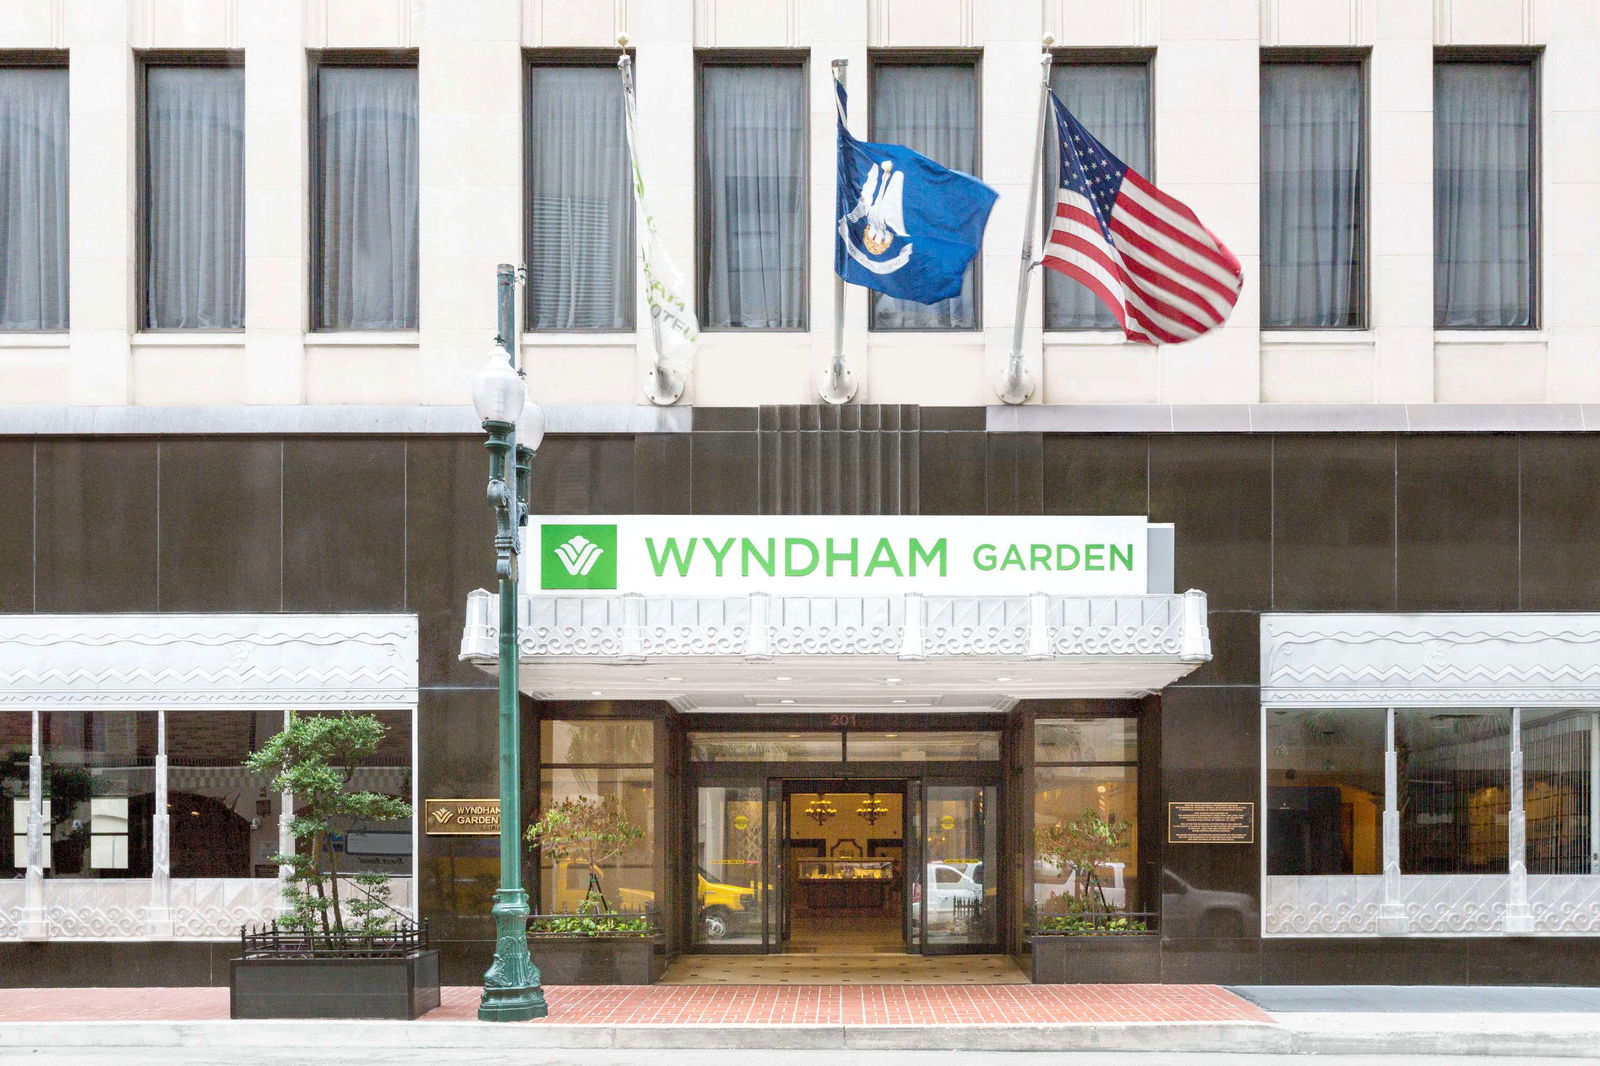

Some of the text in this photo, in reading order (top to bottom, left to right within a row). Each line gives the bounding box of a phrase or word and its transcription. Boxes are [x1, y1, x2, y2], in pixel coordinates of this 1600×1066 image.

[645, 538, 1133, 576] WYNDHAM GARDEN
[457, 816, 499, 825] GARDEN
